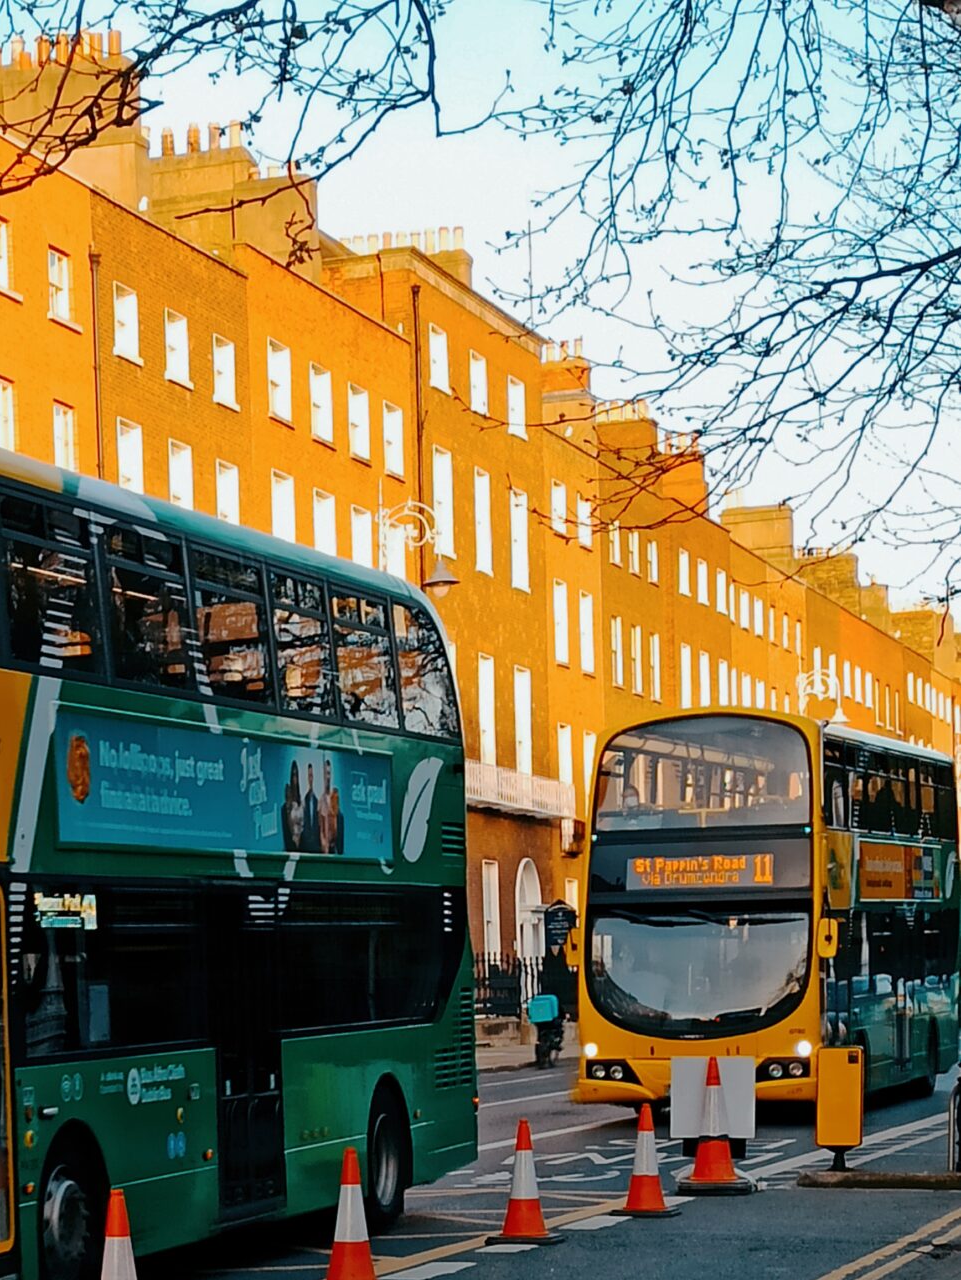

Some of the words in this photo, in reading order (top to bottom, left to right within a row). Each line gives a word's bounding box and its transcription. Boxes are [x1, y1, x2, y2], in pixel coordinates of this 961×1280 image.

[174, 750, 196, 784] just
[196, 757, 224, 787] great
[635, 857, 651, 873] St
[712, 855, 747, 871] Road
[753, 853, 773, 885] 11
